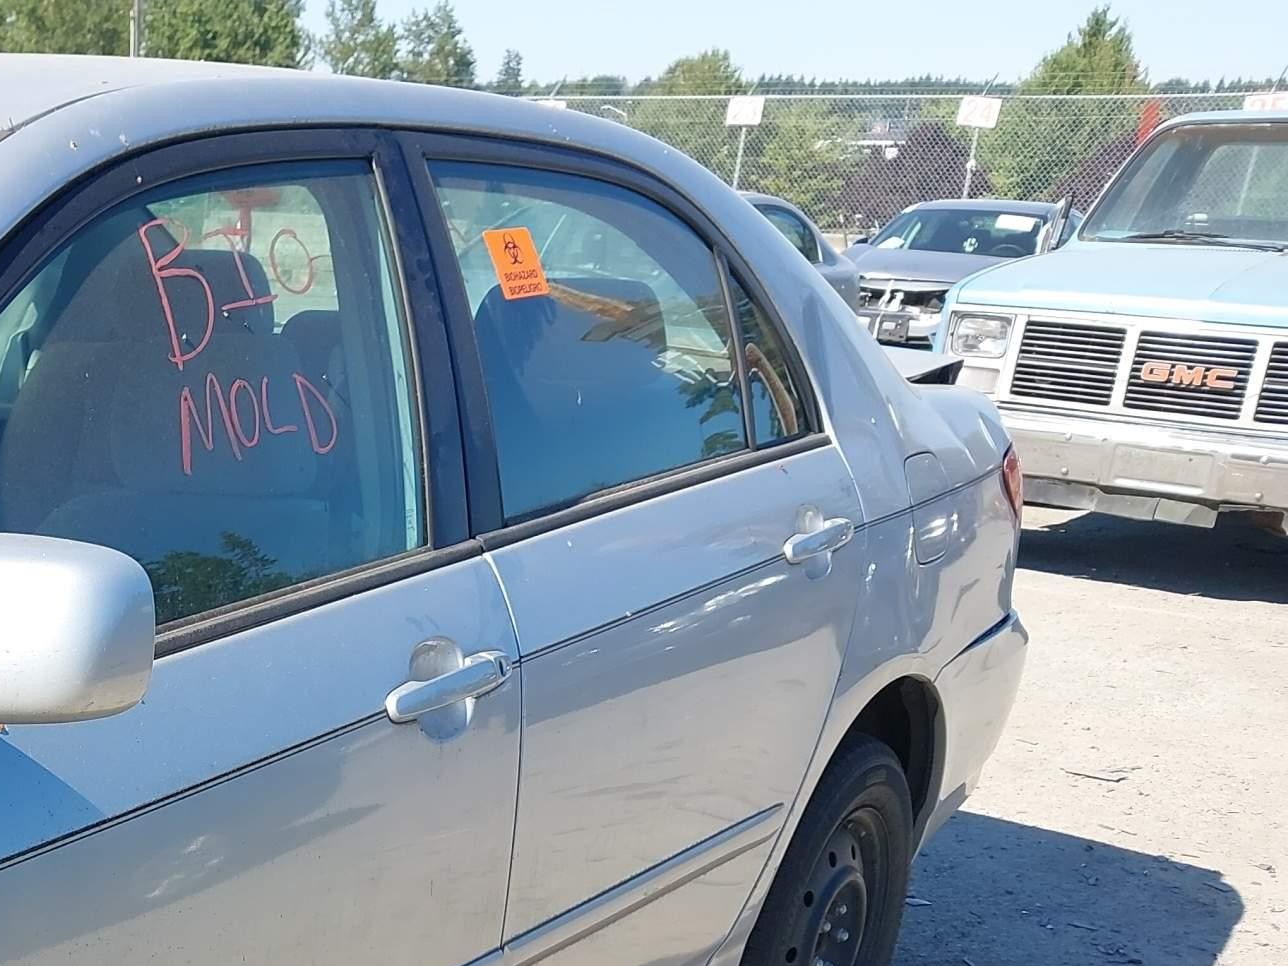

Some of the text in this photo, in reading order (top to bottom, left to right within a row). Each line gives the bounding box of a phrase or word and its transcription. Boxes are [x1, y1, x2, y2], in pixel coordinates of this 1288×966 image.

[504, 269, 538, 282] BIOHAZARD
[509, 283, 542, 295] BIOPELIGRO
[138, 217, 315, 370] BIO
[1141, 361, 1239, 390] GMC
[179, 371, 338, 476] MOLD
